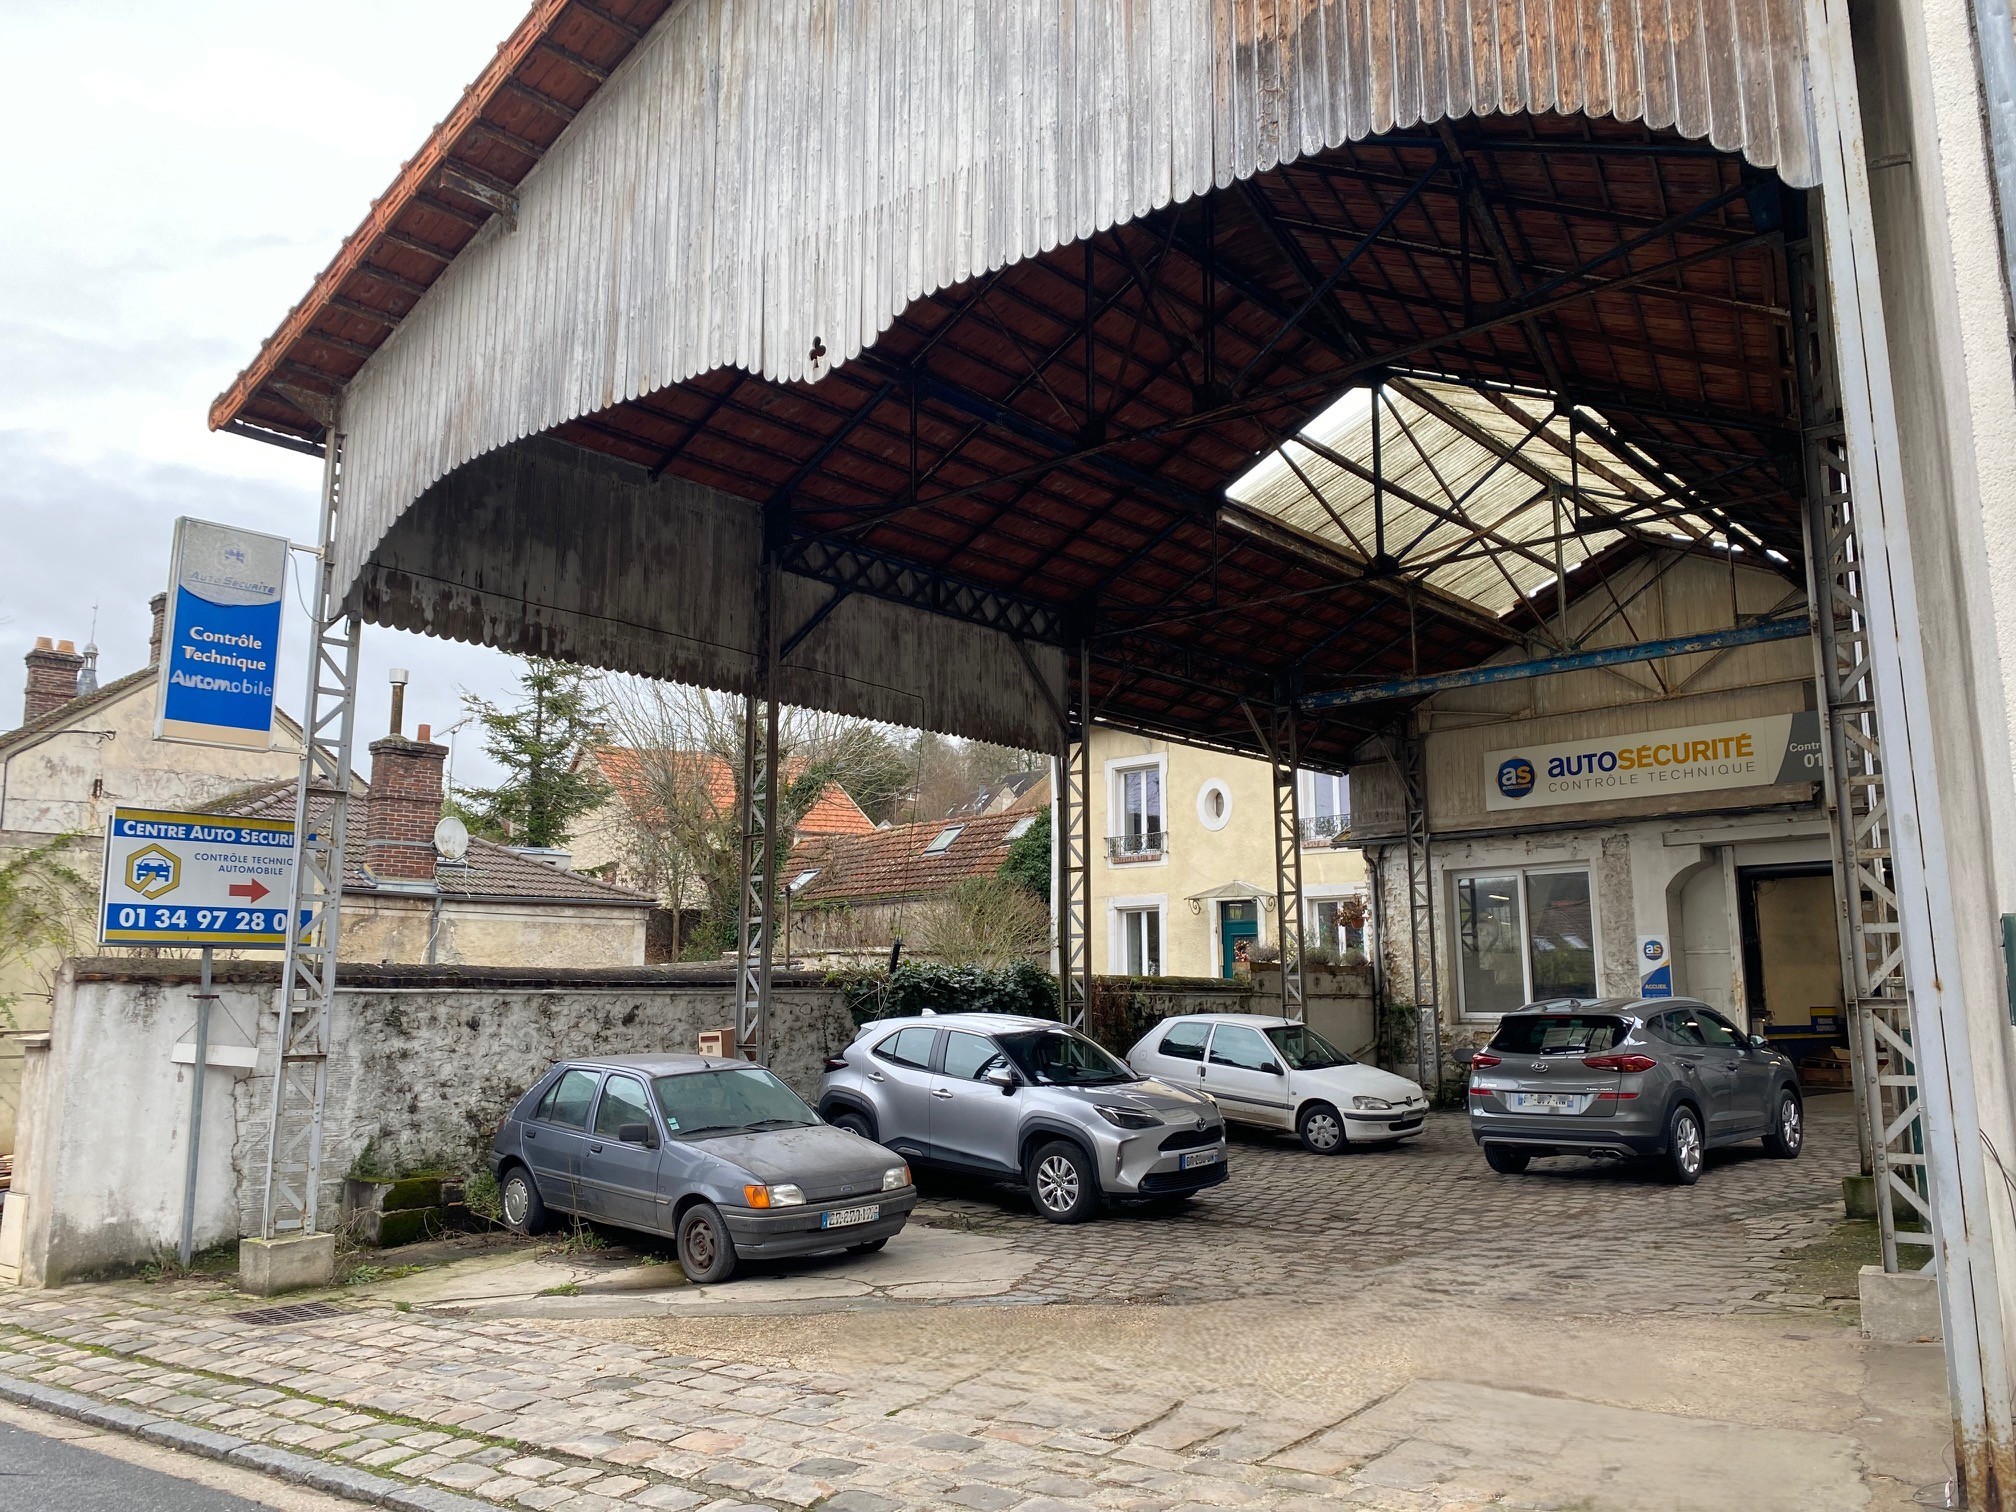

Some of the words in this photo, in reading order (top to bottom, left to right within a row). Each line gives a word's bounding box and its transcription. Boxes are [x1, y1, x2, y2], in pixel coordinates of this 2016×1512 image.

[190, 570, 219, 584] AUTO
[189, 626, 262, 650] Contrôle
[182, 645, 267, 673] Technique
[170, 669, 273, 697] Automobile
[1789, 741, 1821, 752] Contr
[1804, 752, 1824, 768] 01
[1501, 765, 1531, 786] as
[1548, 774, 1639, 793] CONTRÔLE
[1648, 761, 1756, 782] TECHNIQUE
[123, 820, 186, 839] CENTRE
[190, 825, 236, 842] AUTO
[240, 829, 295, 846] SECURI
[194, 852, 249, 864] CONTRÔLE
[218, 865, 284, 876] AUTOMOBILE
[119, 907, 146, 928] 01
[154, 908, 188, 928] 34
[197, 910, 228, 930] 97
[235, 911, 265, 931] 28
[1645, 944, 1661, 954] as
